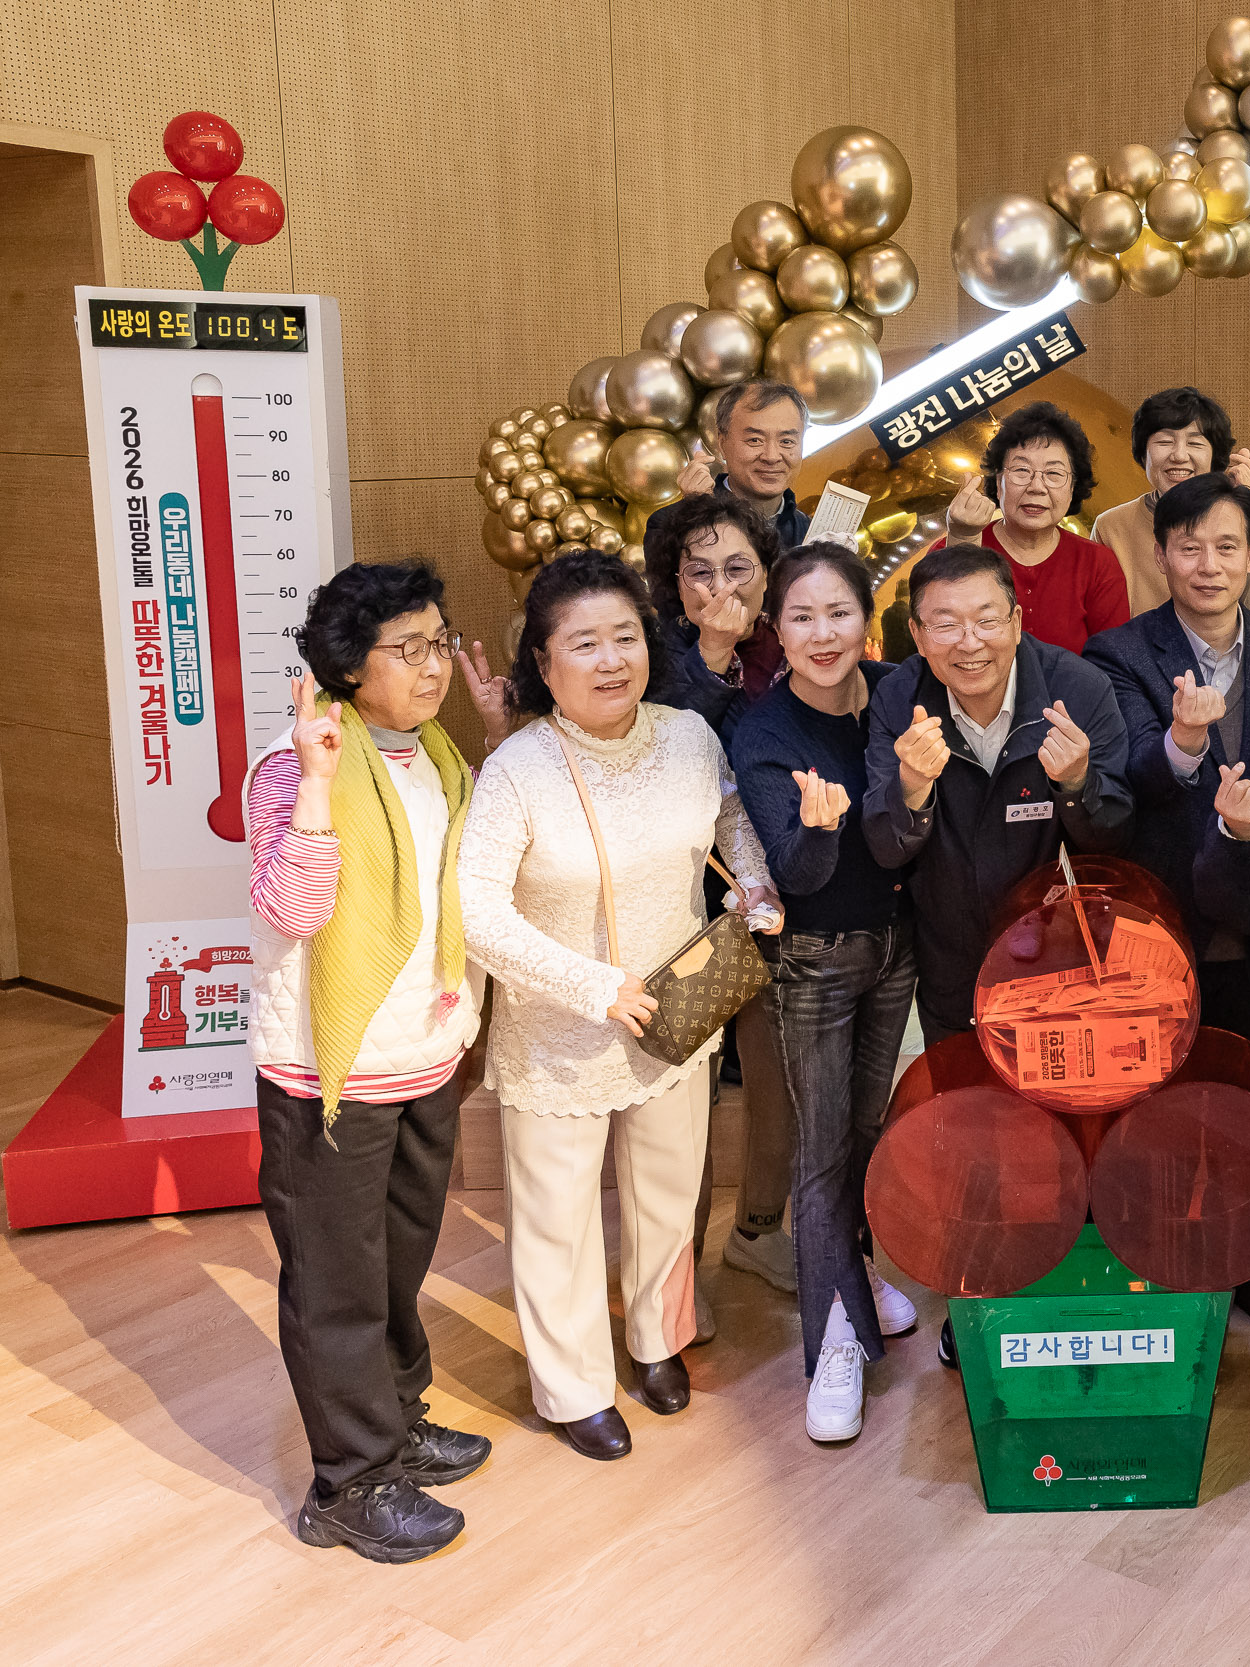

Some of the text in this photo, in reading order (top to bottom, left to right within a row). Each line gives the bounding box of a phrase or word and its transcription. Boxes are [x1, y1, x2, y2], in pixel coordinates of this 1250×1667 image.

[100, 309, 151, 338] 사랑의
[158, 311, 192, 338] 온도
[883, 323, 1075, 448] 광진 나눔의 날
[265, 394, 293, 406] 100
[269, 431, 288, 442] 90
[272, 471, 290, 482] 80
[275, 510, 293, 521] 70
[277, 549, 295, 560] 60
[120, 406, 172, 786] 2026 희망온돌 따뜻한 겨울나기
[279, 587, 297, 598] 50
[163, 507, 202, 714] 우리동네 나눔캠페인
[285, 666, 302, 677] 30
[287, 705, 295, 716] 2
[211, 950, 252, 962] 희망202
[1049, 1030, 1065, 1080] 따뜻한
[169, 1071, 233, 1087] 사랑의열매
[1006, 1334, 1168, 1363] 감사합니다!
